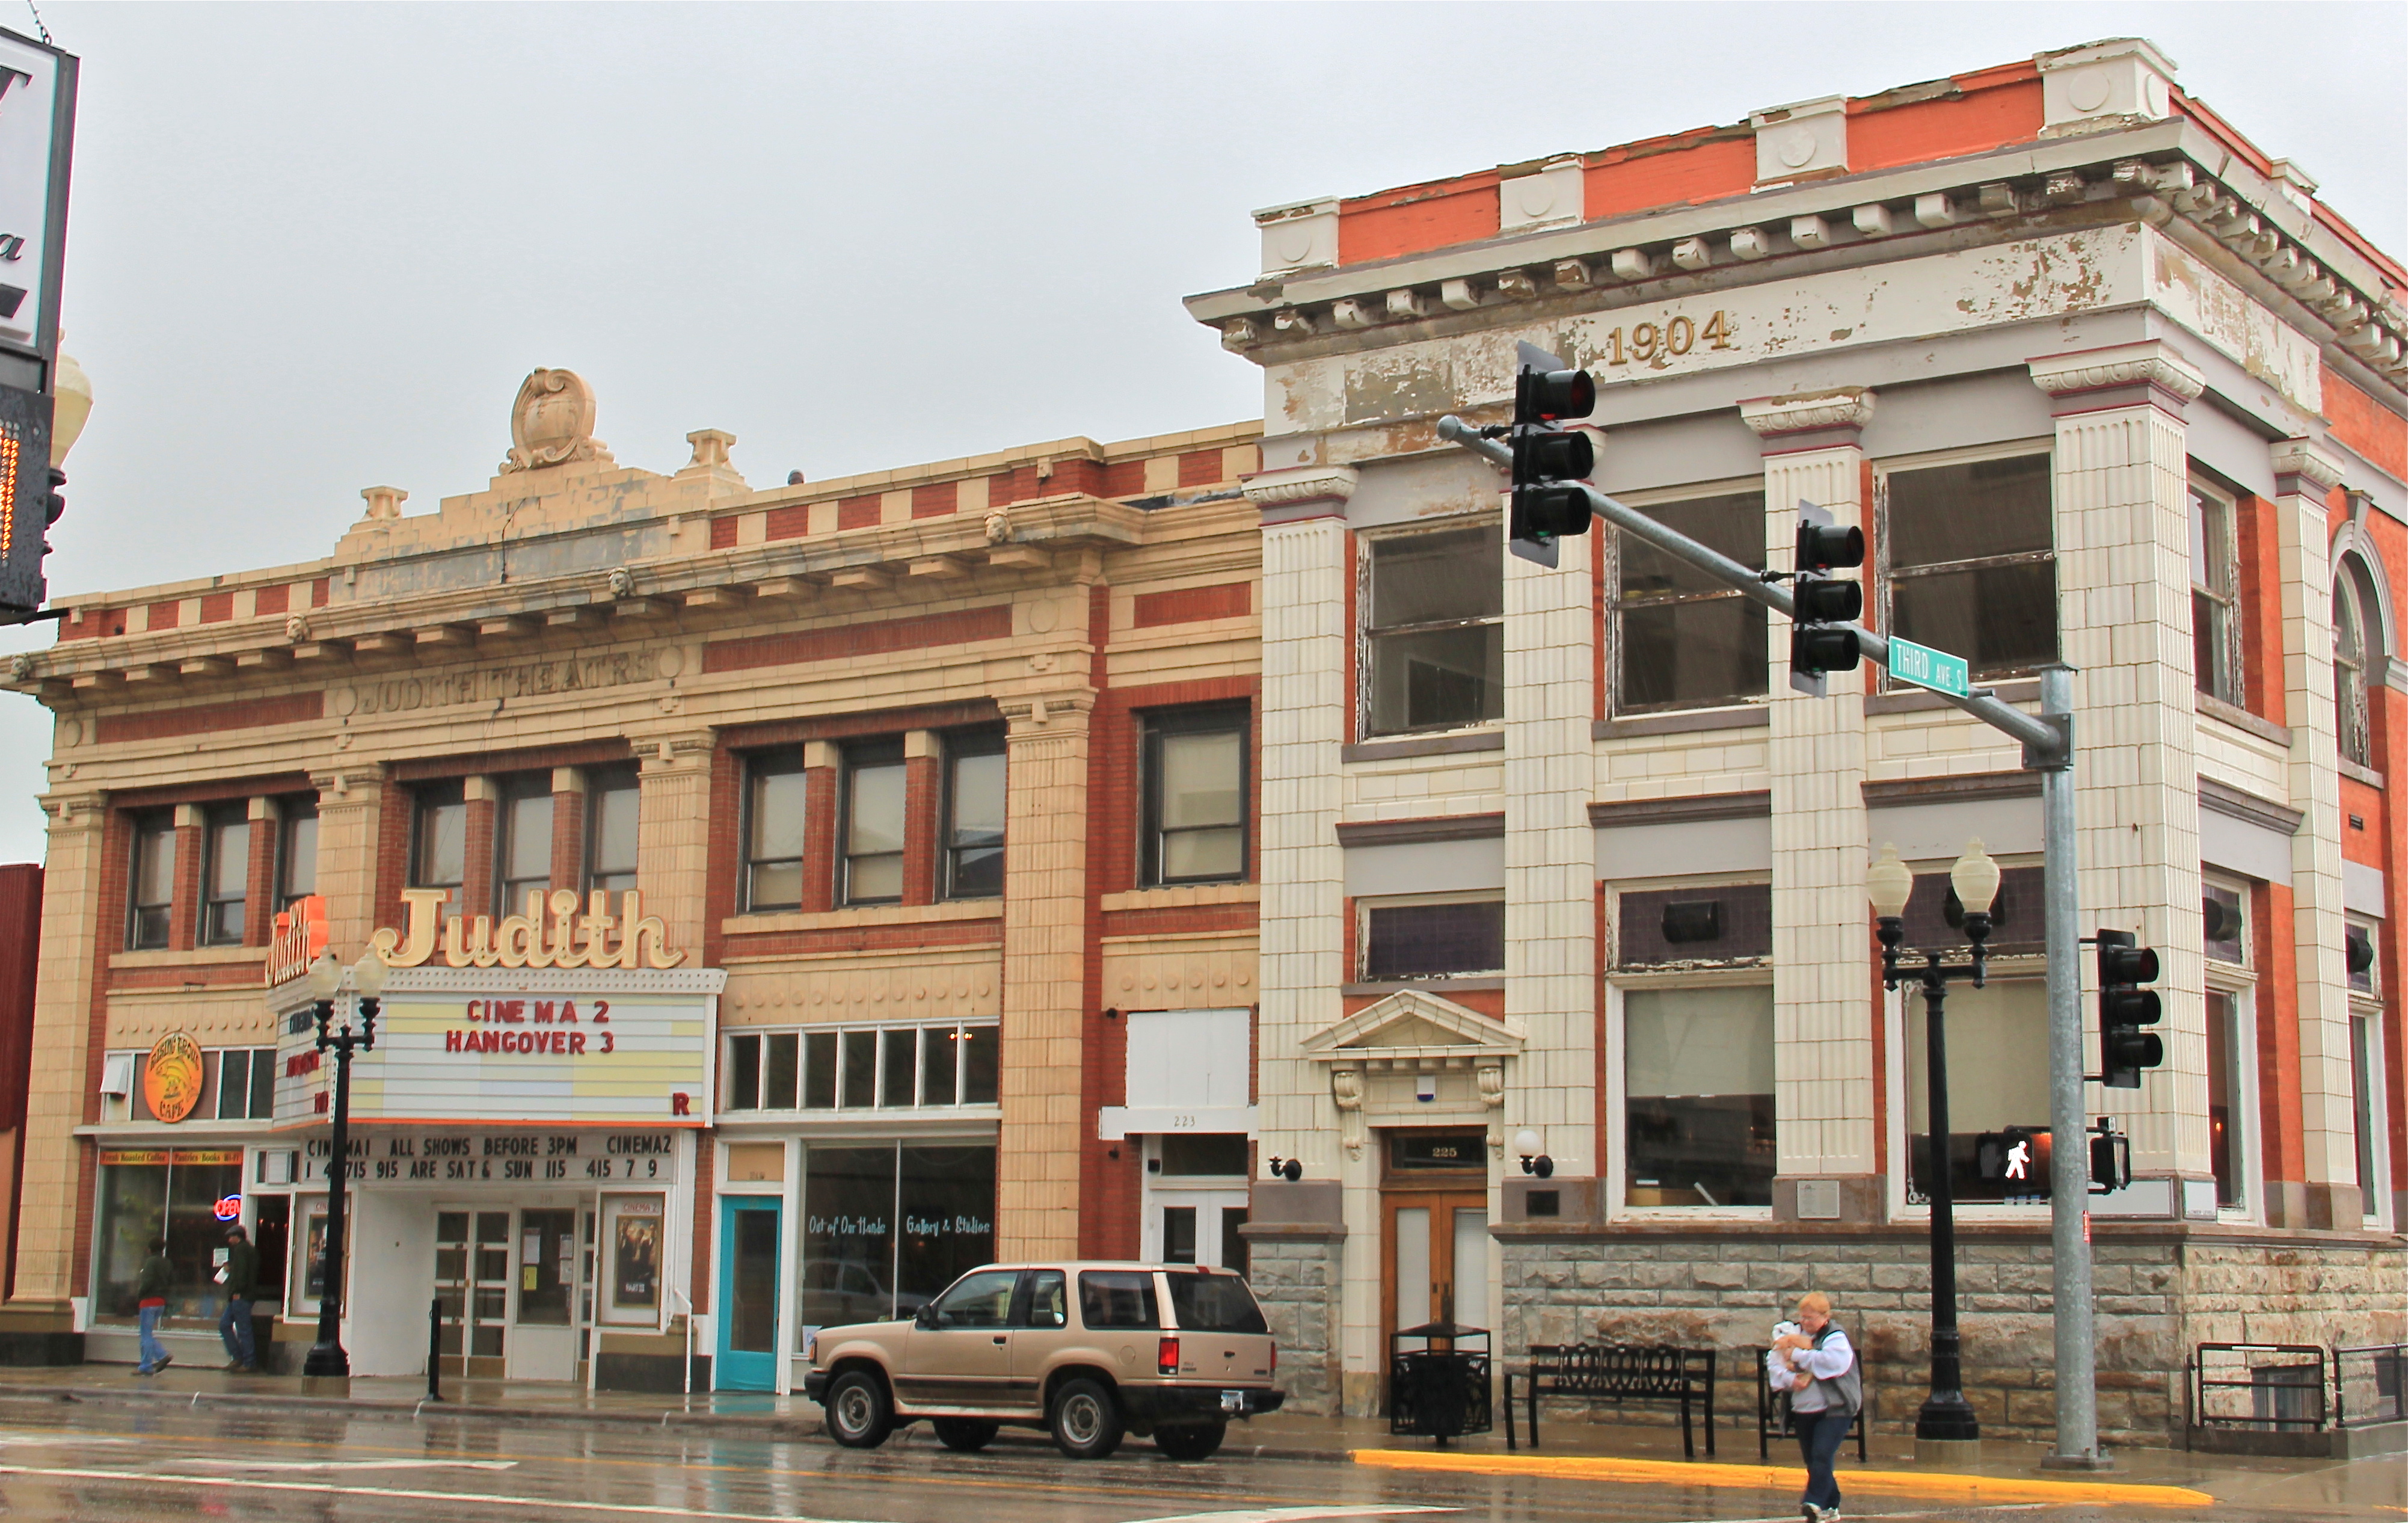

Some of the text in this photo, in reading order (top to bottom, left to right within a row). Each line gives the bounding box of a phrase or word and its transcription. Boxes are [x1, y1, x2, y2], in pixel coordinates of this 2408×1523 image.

[1608, 309, 1731, 366] 1904
[1896, 643, 1962, 691] THIRD AVE S
[361, 650, 655, 714] JUDITH THEATRE
[372, 887, 687, 969] Judith
[467, 999, 610, 1024] CINEMA 2
[446, 1030, 615, 1054] HANGOVER 3
[672, 1092, 690, 1116] R
[1174, 1115, 1195, 1127] 223
[390, 1137, 414, 1157] ALL
[423, 1137, 471, 1156] SHOWS
[484, 1136, 539, 1155] BEFORE
[547, 1136, 578, 1155] 3PM
[606, 1134, 672, 1154] CINEMA2
[1433, 1147, 1457, 1158] 225
[345, 1160, 367, 1178] 715
[377, 1160, 399, 1178] 915
[410, 1160, 437, 1178] ARE
[447, 1160, 476, 1178] SAT
[482, 1159, 491, 1178] &
[504, 1160, 533, 1179] SUN
[546, 1160, 567, 1178] 115
[586, 1159, 611, 1178] 415
[626, 1158, 635, 1178] 7
[648, 1158, 657, 1178] 9
[213, 1199, 240, 1216] OPEN
[623, 1204, 650, 1213] CINEMA
[809, 1216, 828, 1234] Out
[827, 1216, 838, 1237] of
[942, 1219, 950, 1232] &
[955, 1215, 990, 1234] Studios
